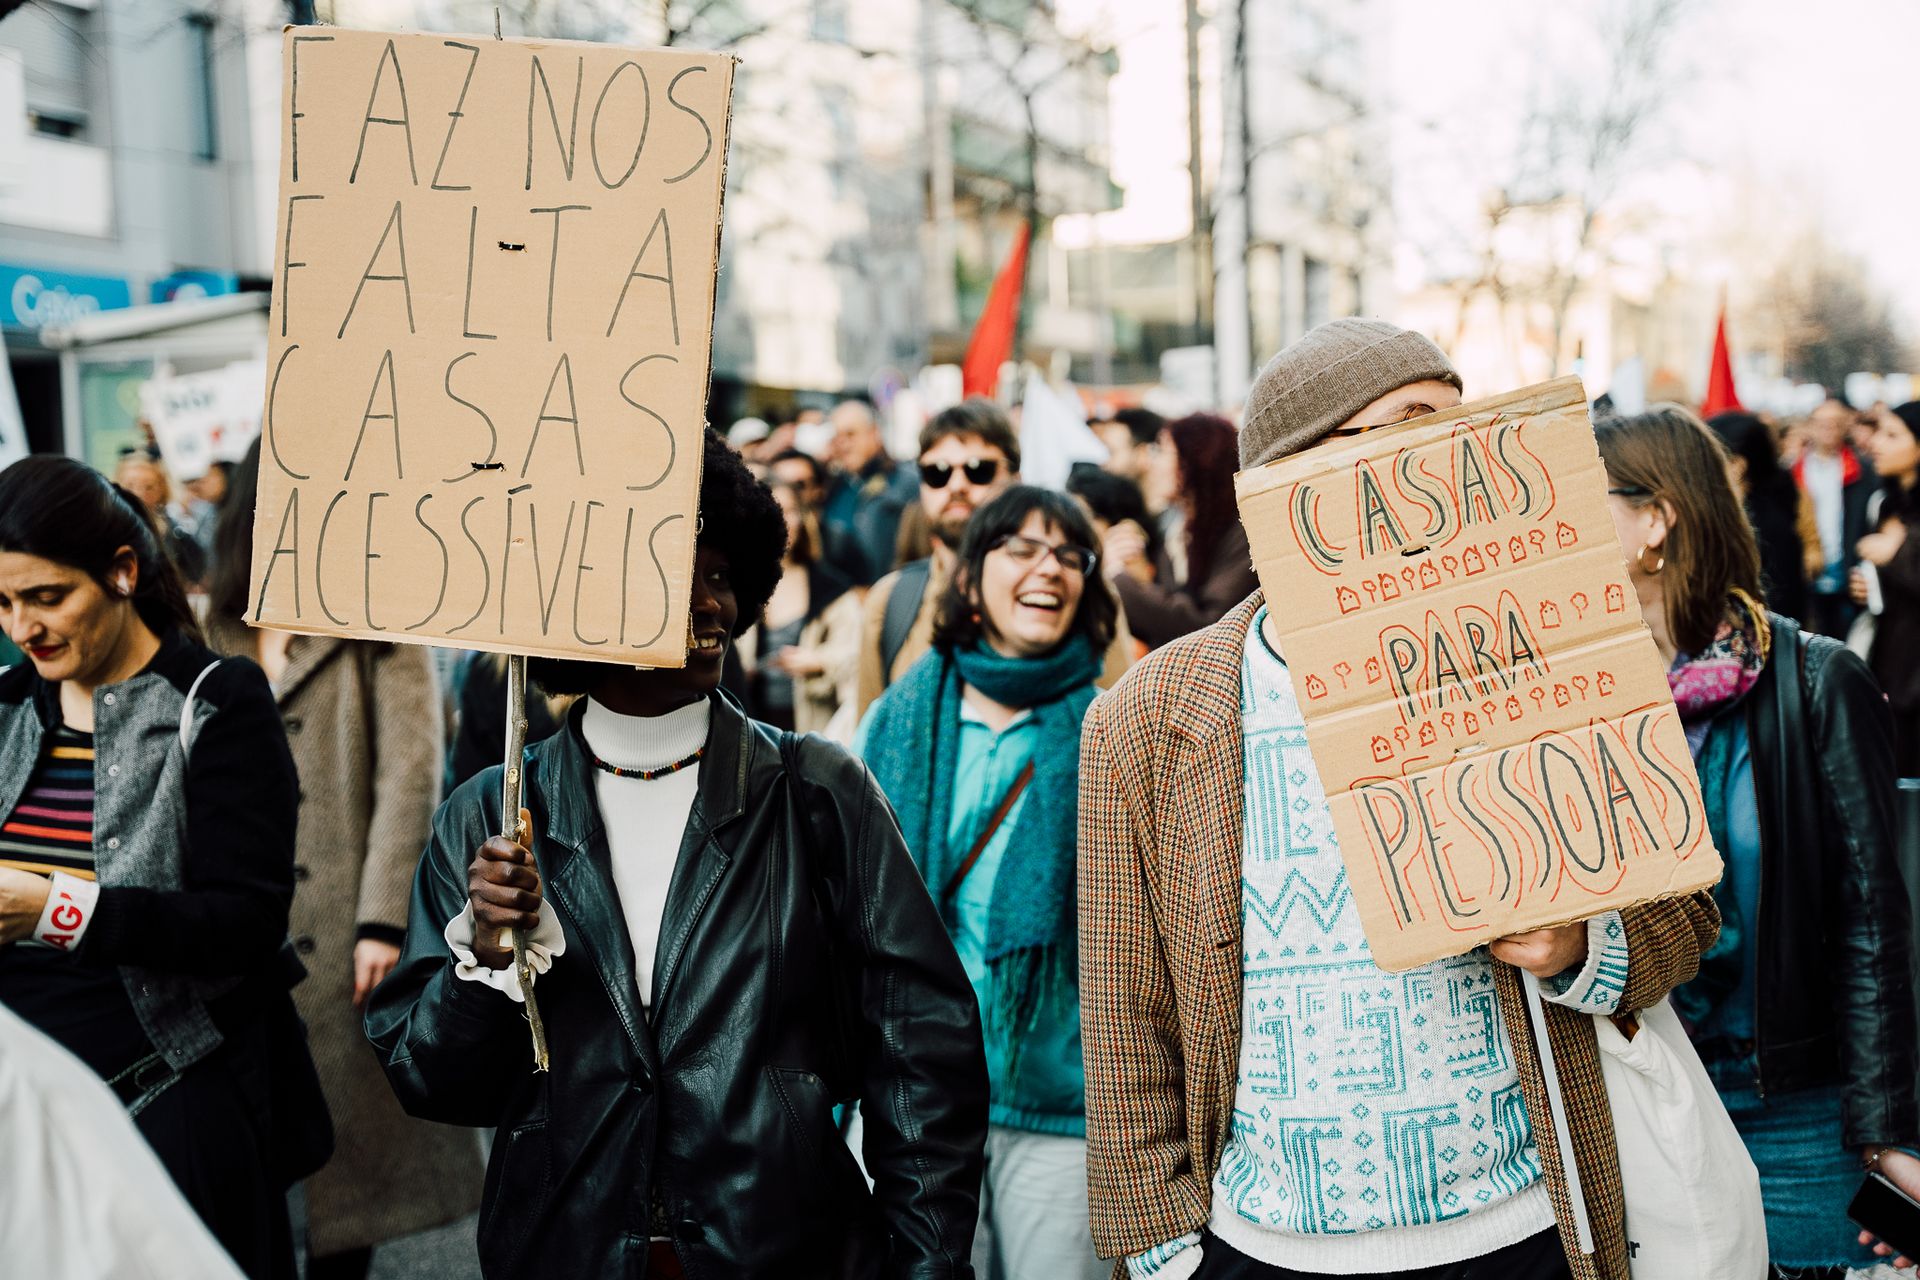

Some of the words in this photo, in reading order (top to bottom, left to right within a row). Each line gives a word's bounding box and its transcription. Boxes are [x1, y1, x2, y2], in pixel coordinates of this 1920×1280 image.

[292, 36, 480, 191] FAZ
[525, 55, 712, 190] NOS
[282, 195, 680, 346] FALTA
[268, 344, 679, 491] CASAS
[1288, 413, 1556, 576] CASAS
[255, 484, 684, 649] ACESSÍVEIS
[1379, 589, 1550, 725] PARA
[1350, 702, 1705, 931] PESSOAS
